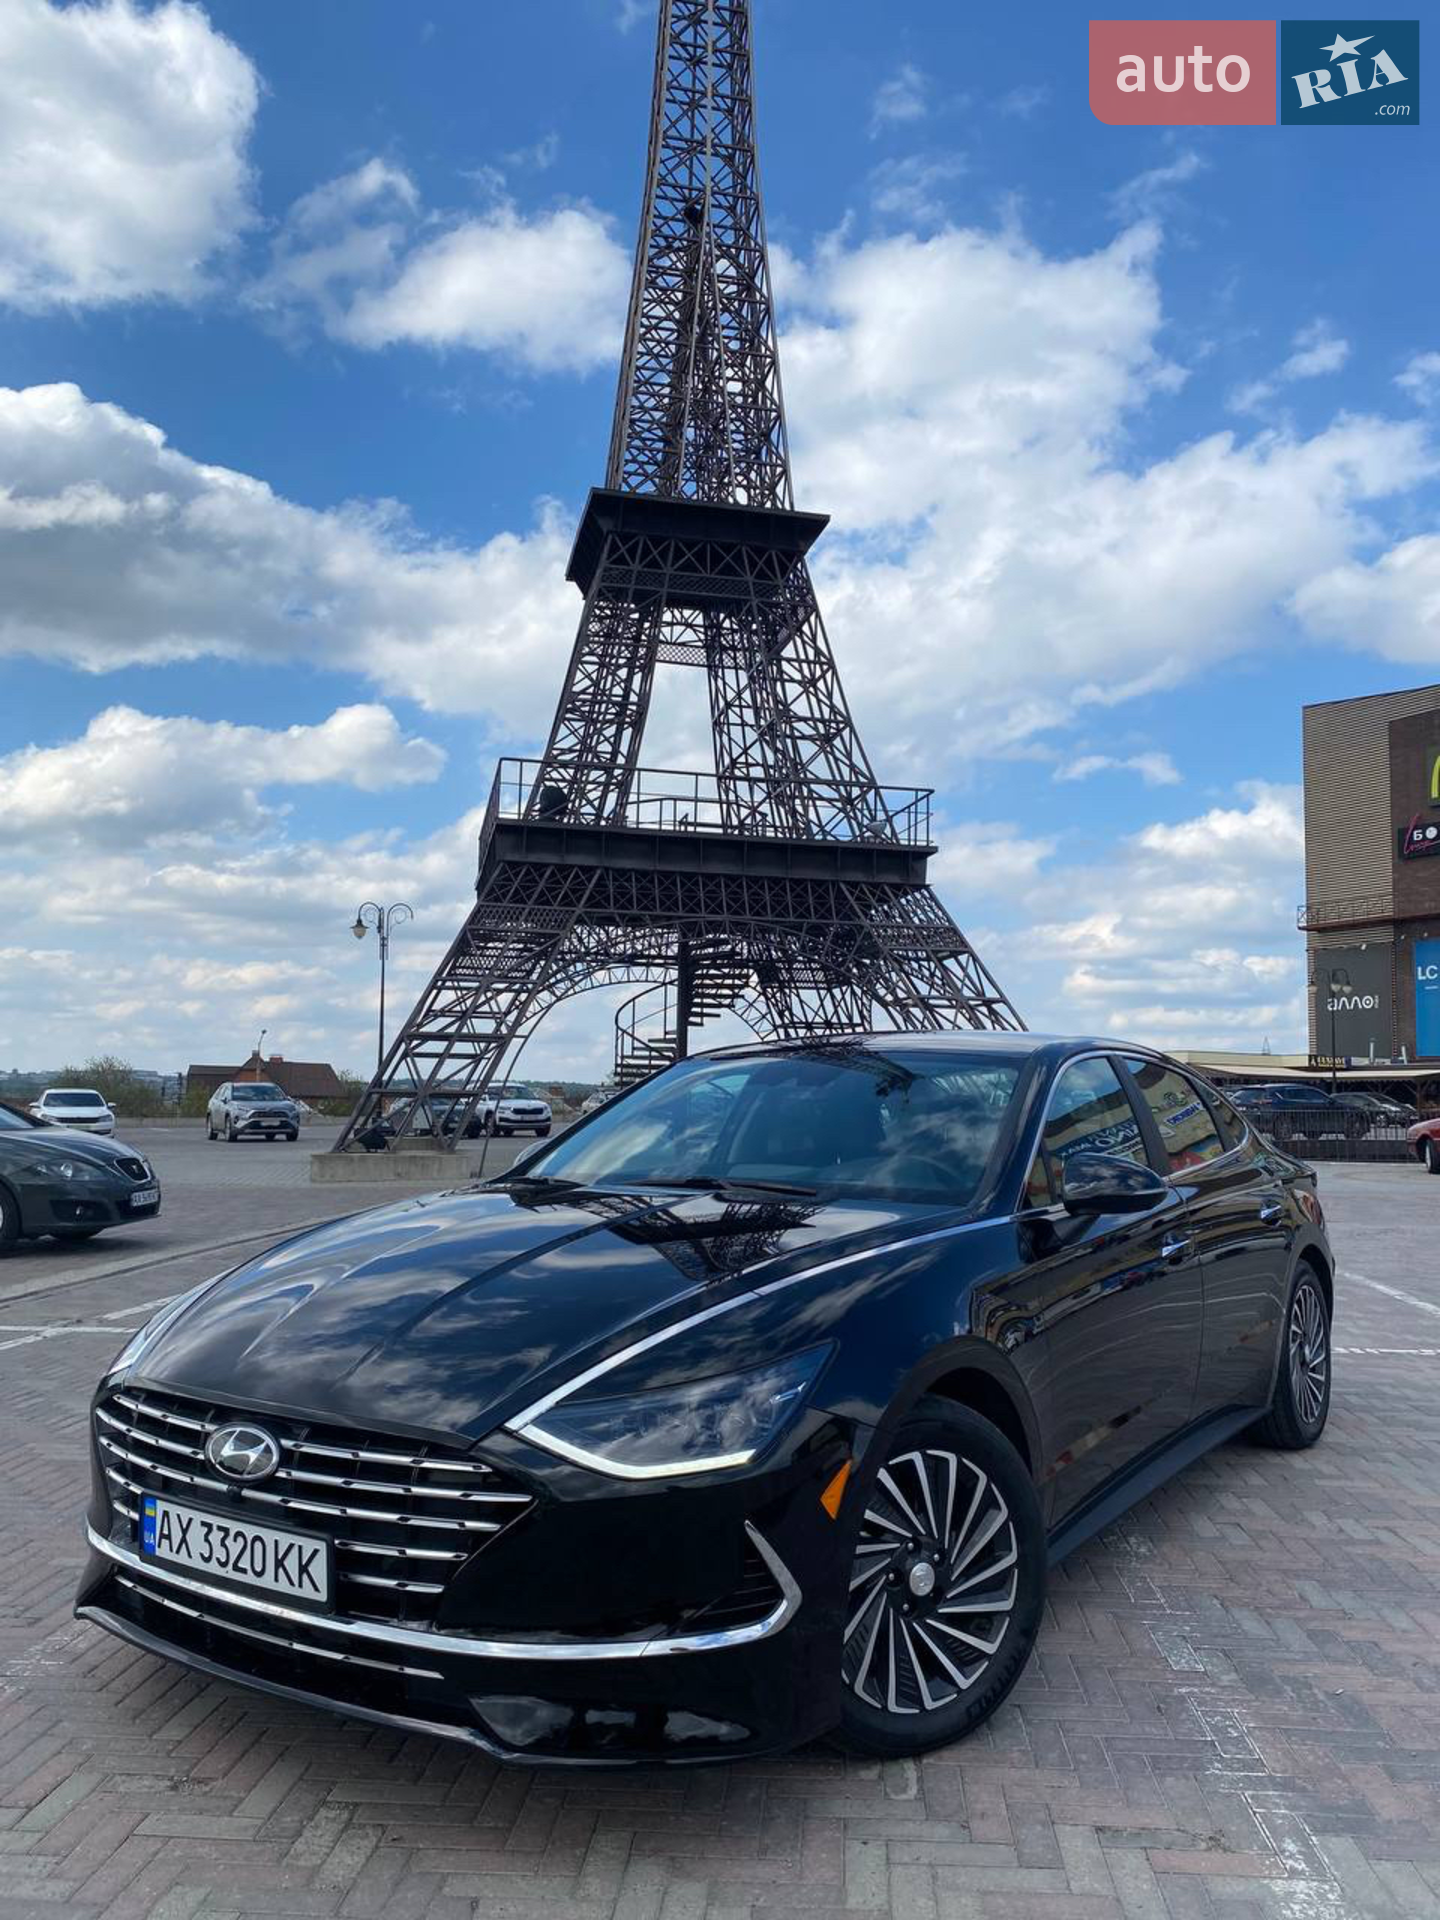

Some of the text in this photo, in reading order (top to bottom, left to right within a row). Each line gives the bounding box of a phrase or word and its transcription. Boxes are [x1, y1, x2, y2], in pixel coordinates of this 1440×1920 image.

[157, 1509, 321, 1594] AX 3320 KK
